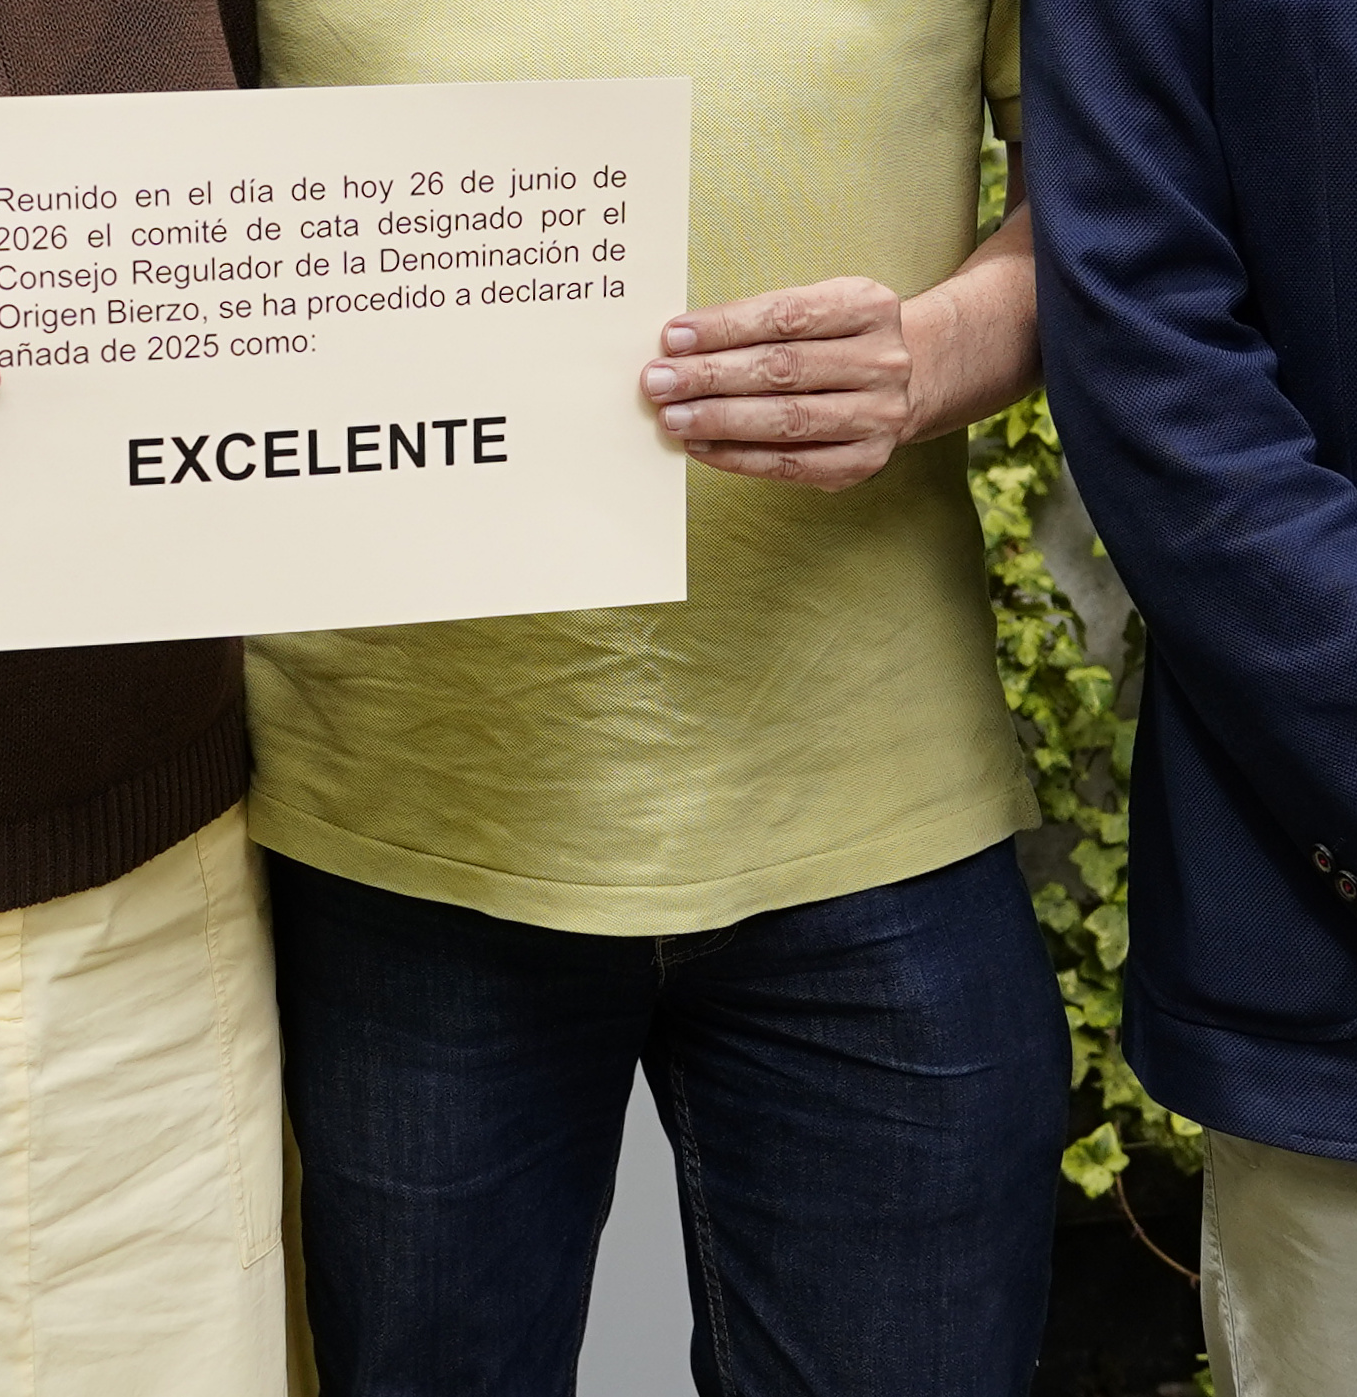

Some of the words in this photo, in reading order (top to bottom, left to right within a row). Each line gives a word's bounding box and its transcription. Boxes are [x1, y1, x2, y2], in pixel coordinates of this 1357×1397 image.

[135, 188, 170, 208] en
[188, 180, 212, 206] el
[229, 178, 274, 205] día
[291, 176, 326, 202] de
[343, 174, 394, 205] hoy
[410, 170, 444, 197] 26
[460, 169, 495, 194] de
[508, 166, 577, 199] junio
[593, 164, 627, 189] de
[87, 222, 111, 249] el
[131, 218, 228, 247] comité
[246, 216, 281, 242] de
[300, 214, 359, 240] cata
[377, 205, 523, 239] designado
[541, 208, 587, 234] por
[603, 200, 626, 225] el
[132, 255, 284, 290] Regulador
[295, 252, 330, 278] de
[343, 250, 366, 275] la
[380, 239, 579, 273] Denominación
[592, 237, 626, 263] de
[107, 299, 208, 325] Bierzo,
[219, 299, 252, 319] se
[263, 292, 297, 317] ha
[307, 284, 446, 321] procedido
[455, 287, 471, 307] a
[481, 278, 594, 305] declarar
[603, 274, 625, 299] la
[100, 337, 136, 364] de
[147, 333, 219, 361] 2025
[230, 334, 316, 357] como:
[128, 415, 508, 487] EXCELENTE
